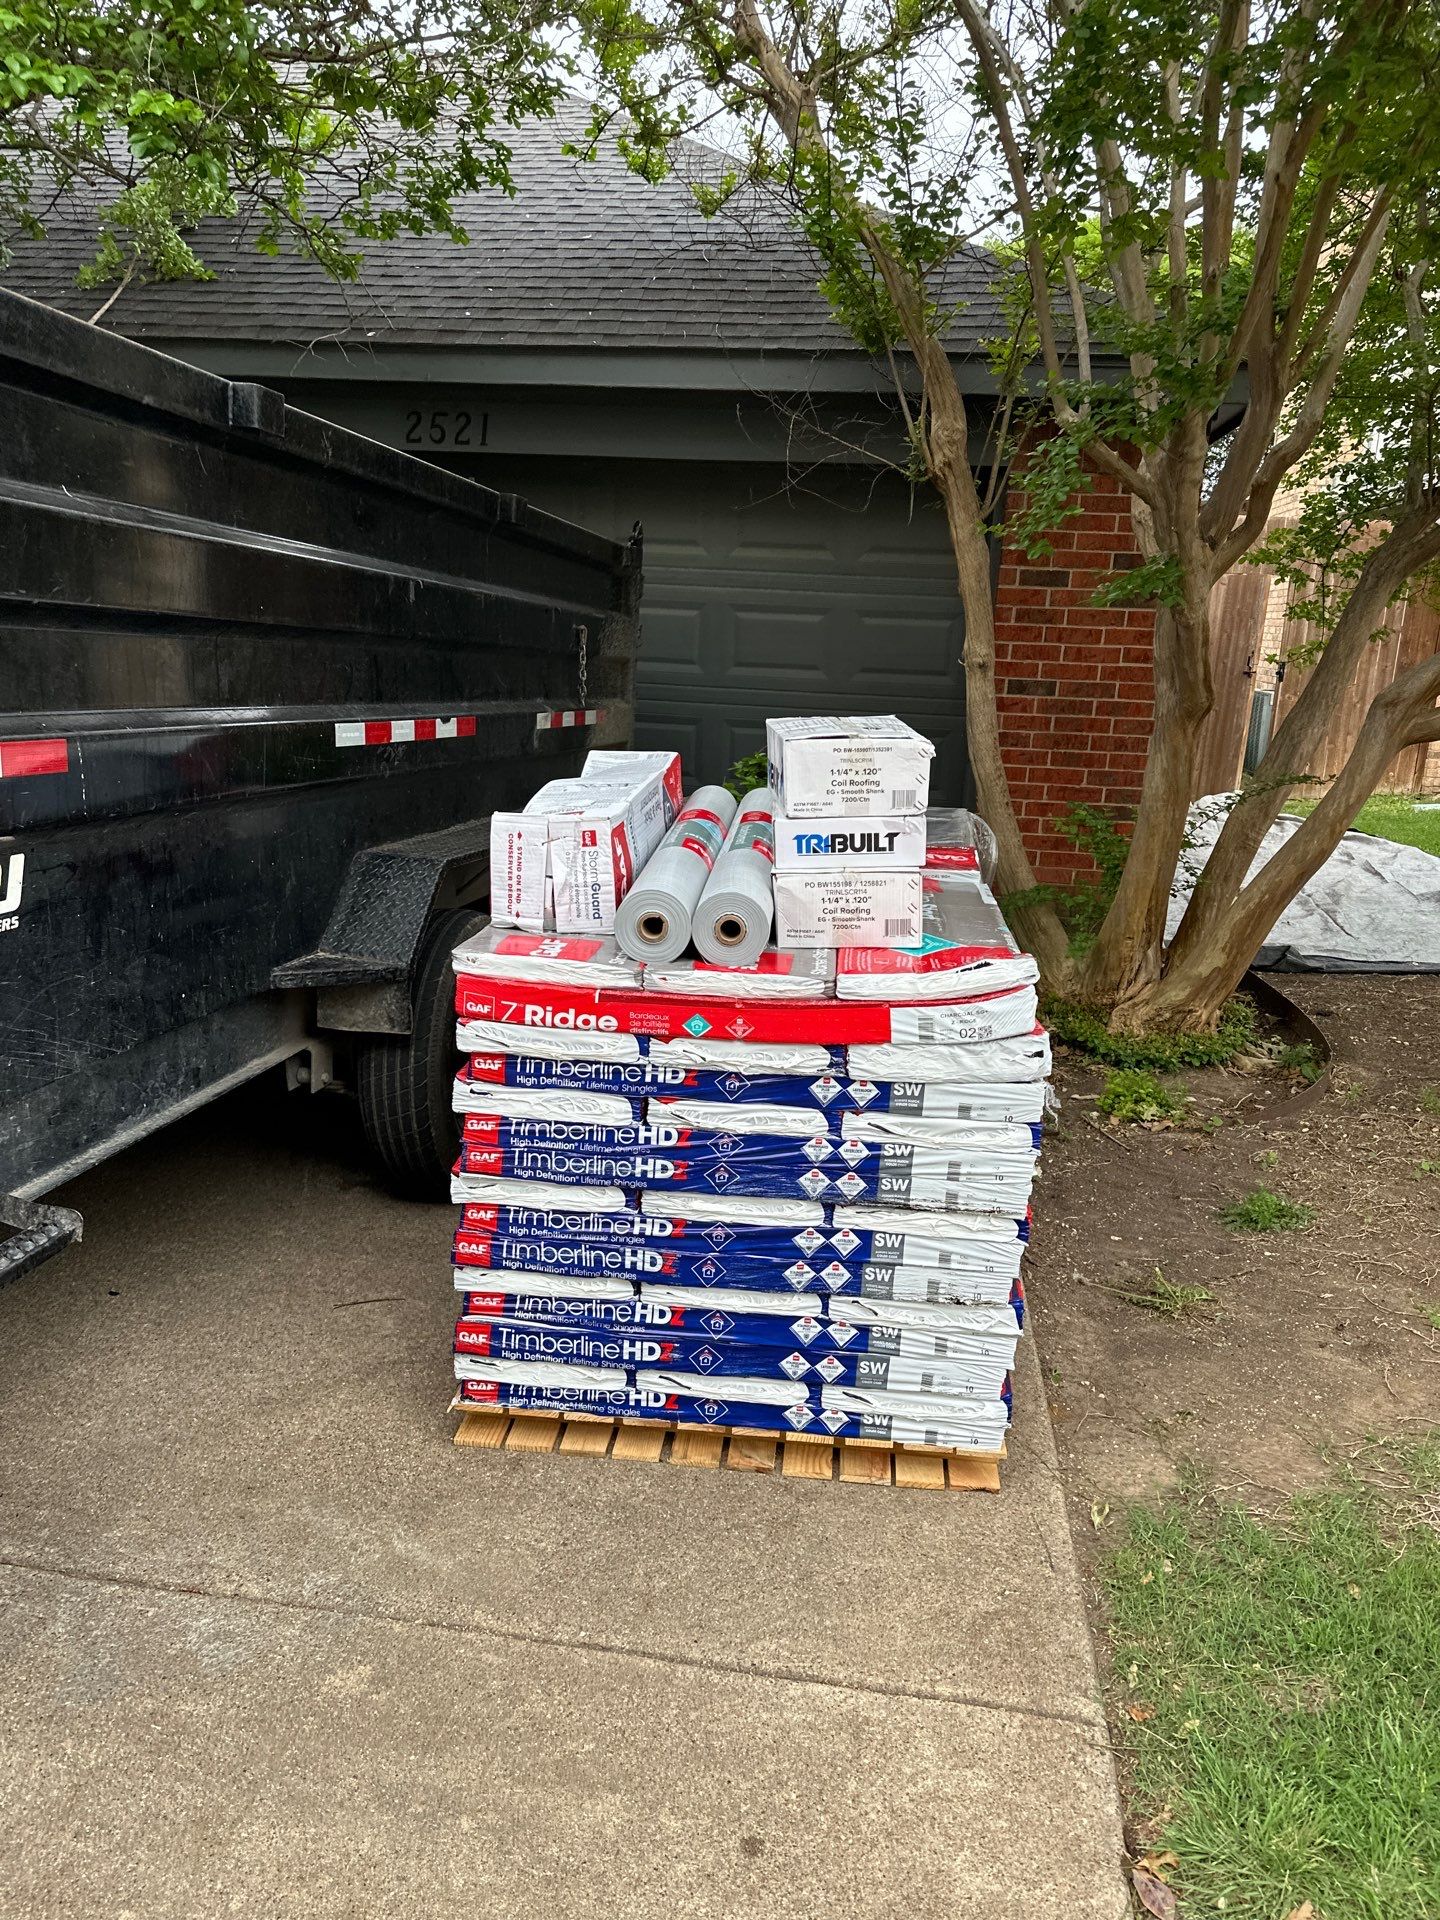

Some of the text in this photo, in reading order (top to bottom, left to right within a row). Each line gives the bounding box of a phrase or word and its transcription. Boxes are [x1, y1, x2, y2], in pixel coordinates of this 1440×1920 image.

[406, 411, 489, 446] 2521
[849, 780, 880, 788] Roofing
[584, 831, 592, 846] GAF
[516, 874, 522, 887] ON
[588, 850, 603, 920] StormGuard
[840, 907, 871, 916] Roofing
[466, 1002, 492, 1014] GAF
[629, 1011, 670, 1021] Bordeaux
[960, 1028, 977, 1038] 02
[474, 1058, 503, 1071] GAF
[516, 1075, 658, 1094] High Definition Lifetime Shingles
[893, 1082, 922, 1096] SW
[467, 1119, 497, 1130] GAF
[508, 1117, 636, 1144] Timberline
[510, 1136, 651, 1154] High Definition Lifetime Shingles
[883, 1144, 912, 1157] SW
[469, 1152, 500, 1162] GAF
[510, 1148, 632, 1178] Timberline
[514, 1168, 648, 1189] High Definition Lifetime Shingles
[880, 1178, 910, 1192] SW
[467, 1209, 496, 1221] GAF
[506, 1206, 631, 1234] Timberline
[508, 1226, 646, 1244] High Definition Lifetime Shingles
[874, 1233, 903, 1248] SW
[458, 1242, 488, 1254] GAF
[500, 1239, 622, 1268] Timberline
[502, 1260, 637, 1280] High Definition Lifetime Shingles
[864, 1267, 893, 1282] SW
[472, 1296, 502, 1306] GAF
[514, 1310, 646, 1333] High Definition Lifetime Shingles
[458, 1332, 488, 1344] GAF
[871, 1326, 898, 1339] SW
[498, 1327, 620, 1360] Timberline
[502, 1350, 636, 1370] High Definition Lifetime Shingles
[859, 1360, 888, 1375] SW
[468, 1382, 497, 1391] GAF
[510, 1396, 528, 1406] High
[607, 1406, 641, 1416] Shingles
[862, 1414, 890, 1427] SW
